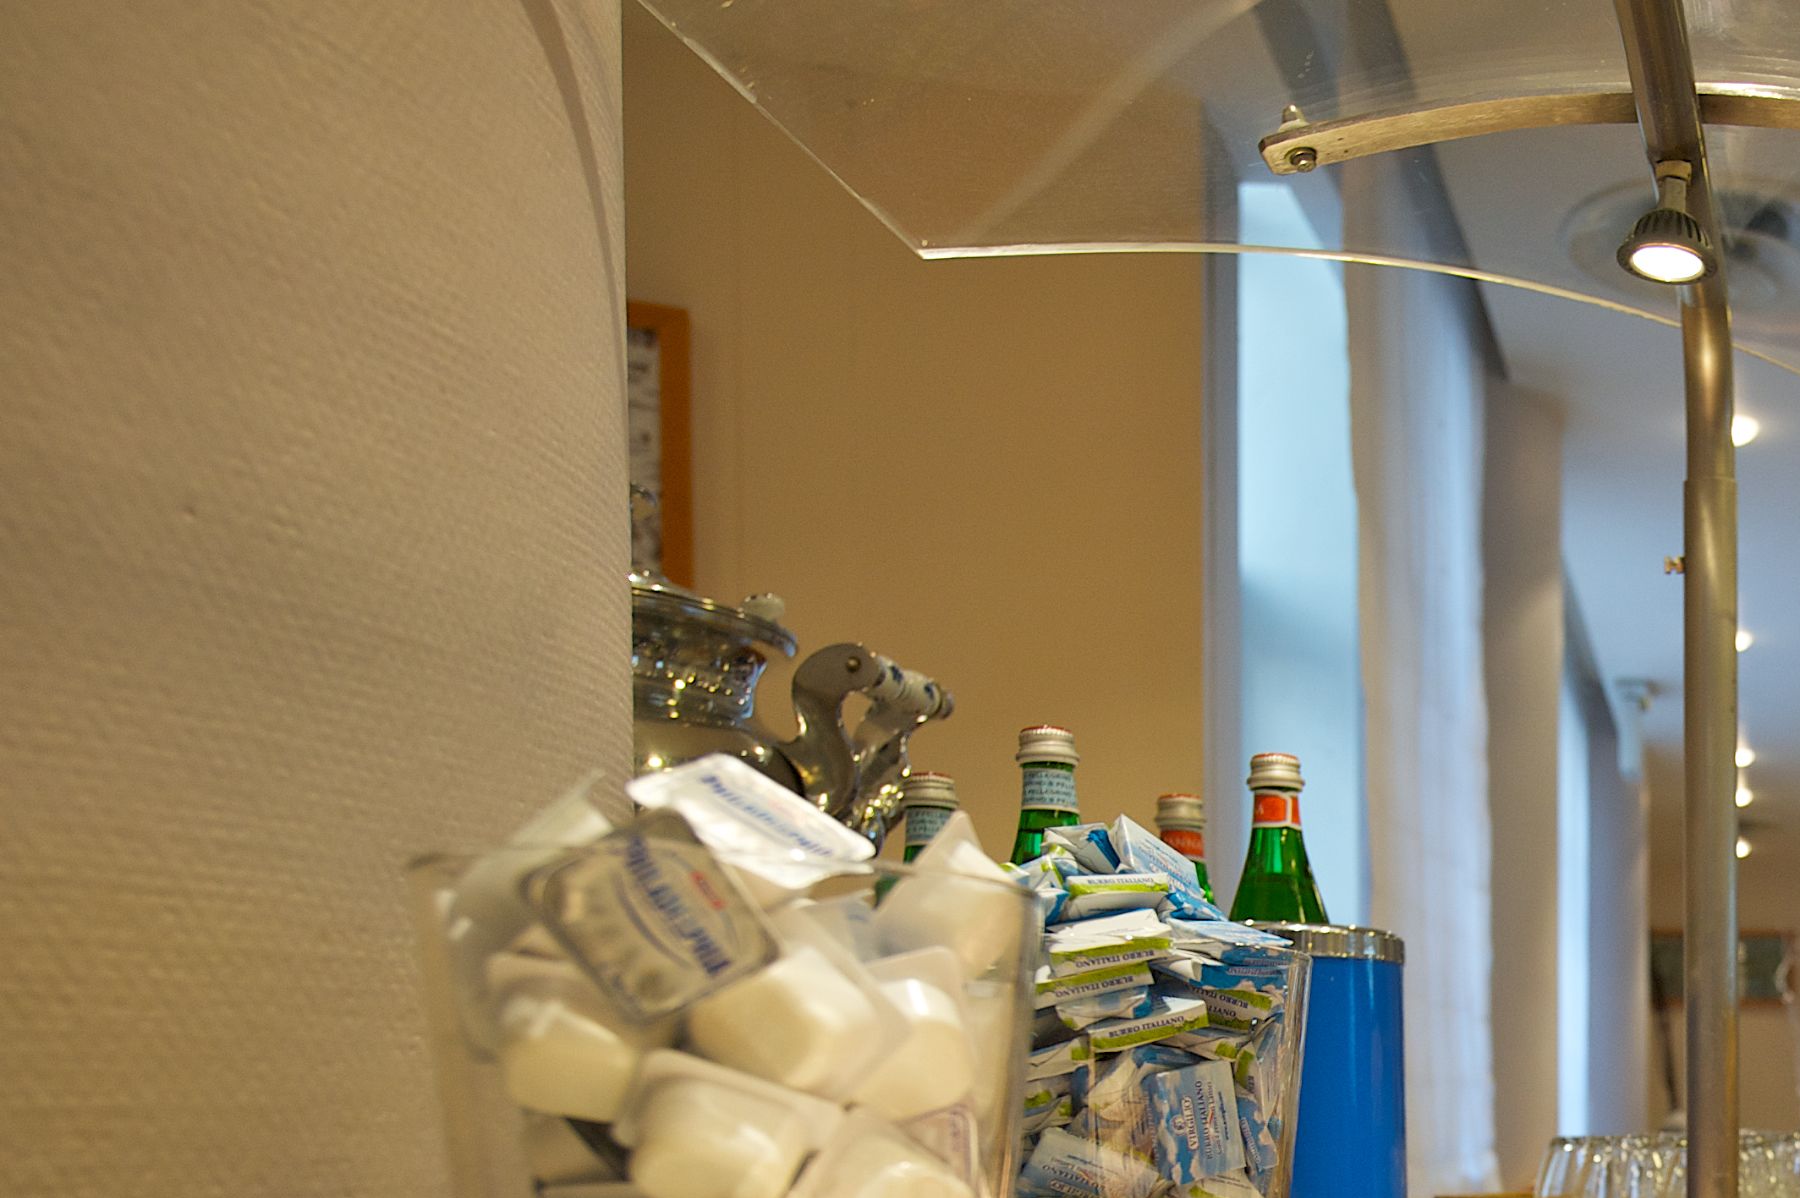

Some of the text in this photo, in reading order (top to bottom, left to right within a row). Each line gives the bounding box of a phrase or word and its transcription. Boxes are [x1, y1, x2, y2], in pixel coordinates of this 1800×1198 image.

[1075, 949, 1156, 968] BURRO ITALIANO
[1055, 975, 1134, 998] BURRO ITALIANO
[1108, 1015, 1186, 1039] BURRO ITALIANO
[1194, 1080, 1208, 1124] ITALIANO
[1183, 1098, 1198, 1148] VIRGILIO
